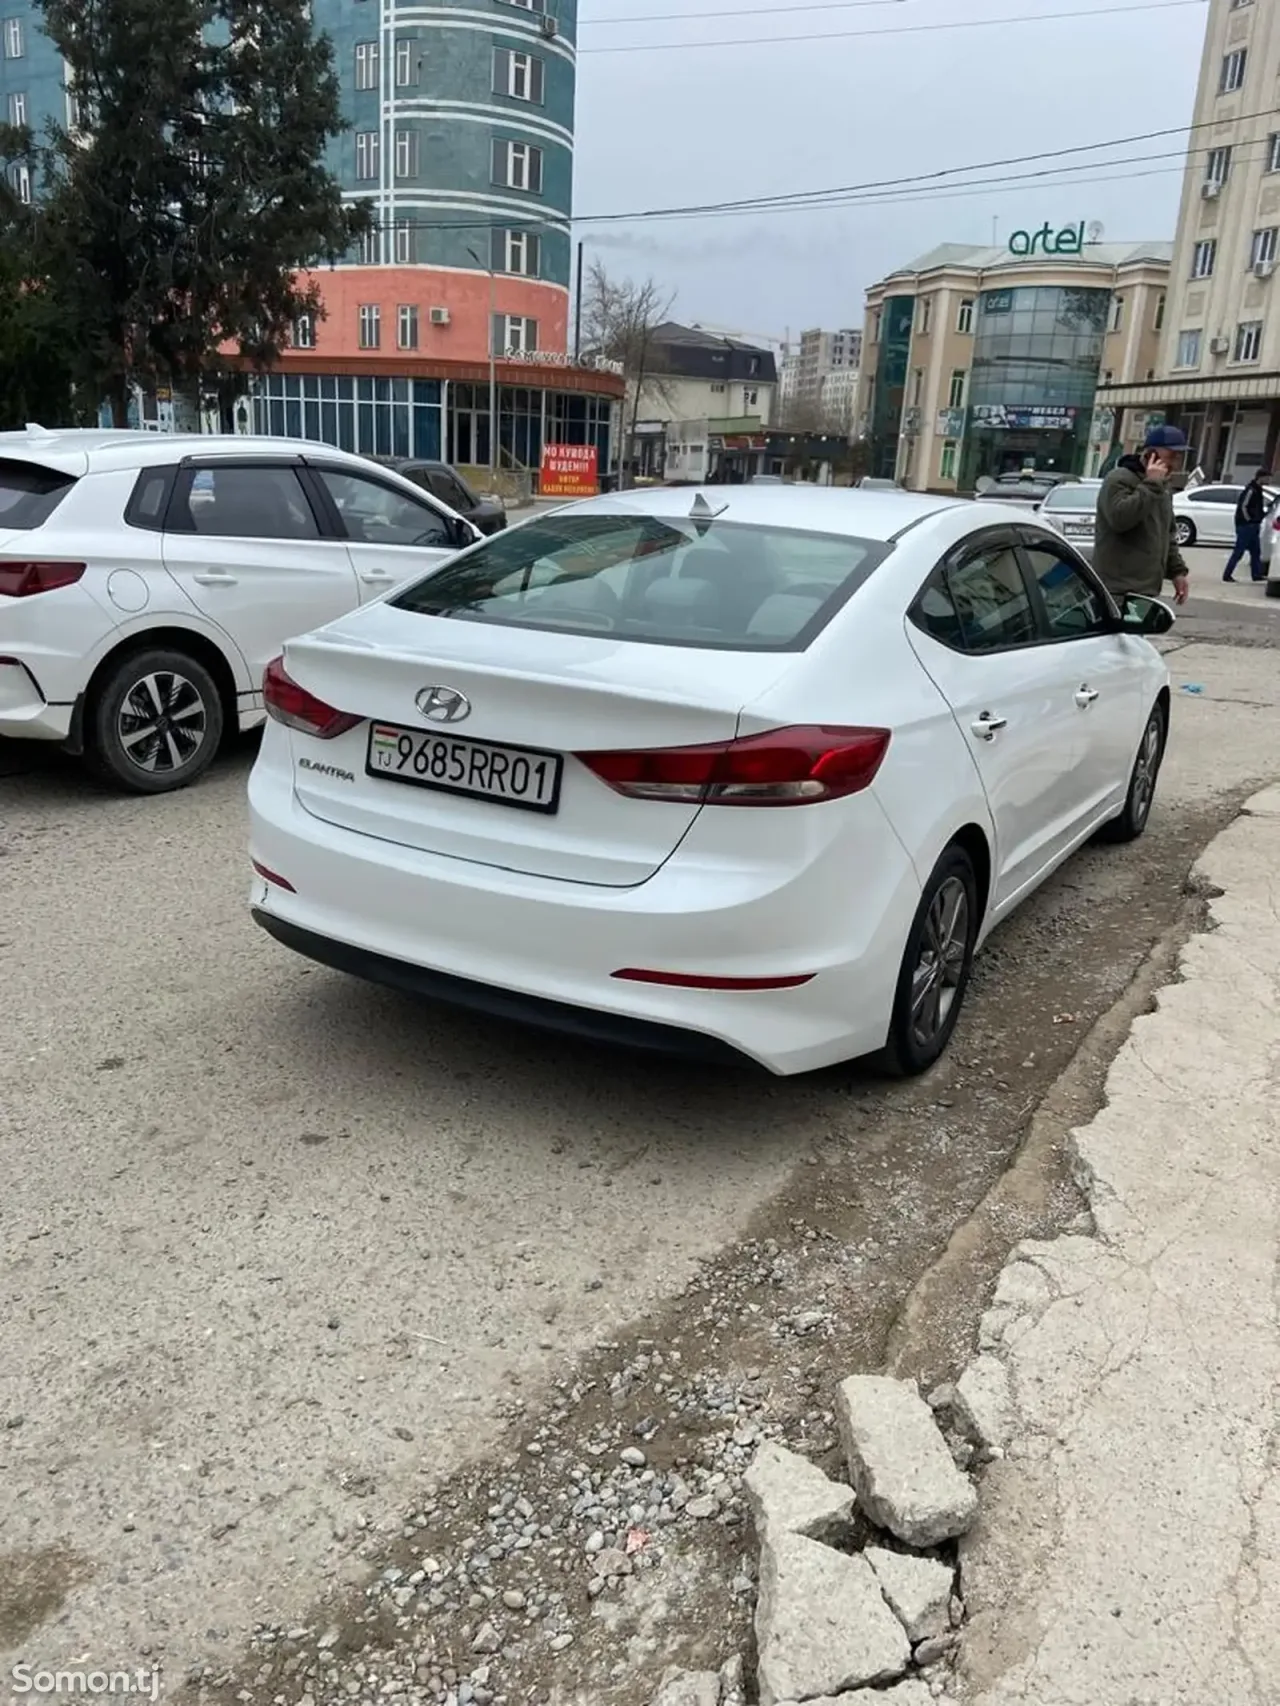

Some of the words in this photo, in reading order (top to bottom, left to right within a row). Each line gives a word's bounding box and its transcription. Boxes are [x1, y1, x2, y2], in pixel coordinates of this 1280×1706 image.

[1009, 220, 1085, 255] artel
[299, 757, 355, 783] ELANTRA
[377, 751, 392, 767] TJ
[397, 734, 547, 800] 9685RR01
